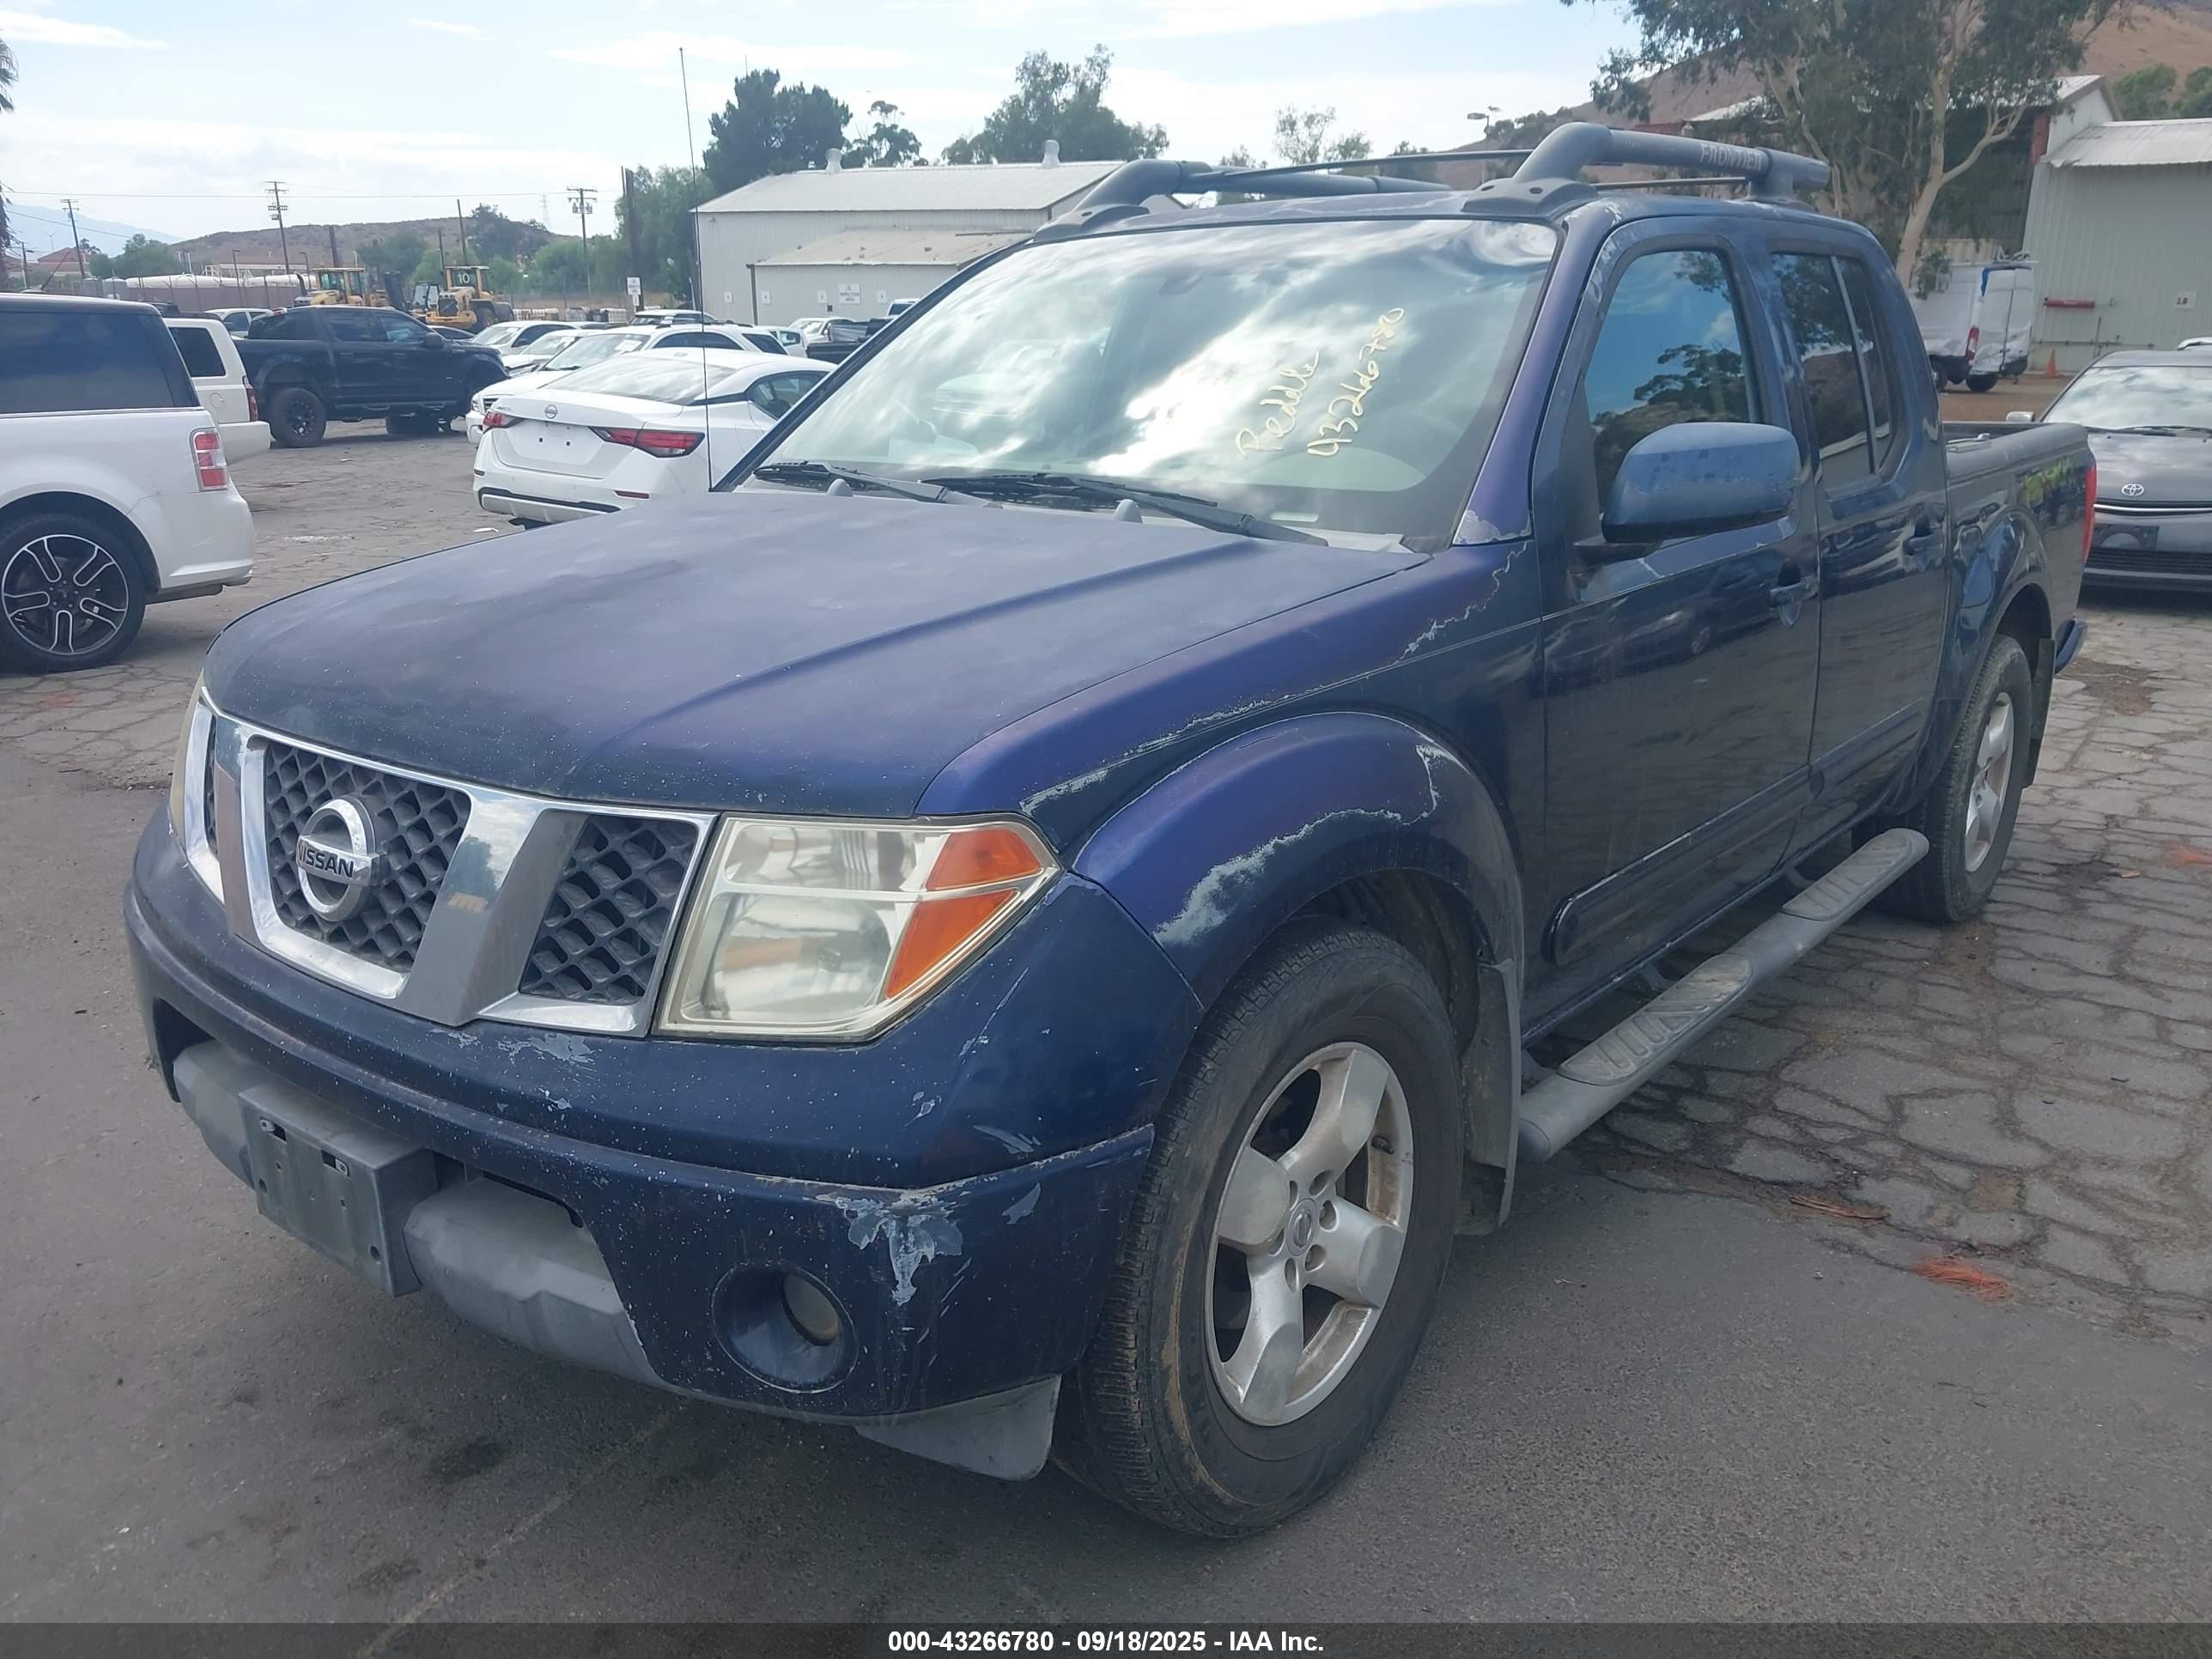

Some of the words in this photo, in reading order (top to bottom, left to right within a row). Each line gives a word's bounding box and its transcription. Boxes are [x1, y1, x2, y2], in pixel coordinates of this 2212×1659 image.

[1699, 143, 1764, 171] FRONTIER
[458, 272, 471, 284] 10
[298, 843, 355, 878] NISSAN
